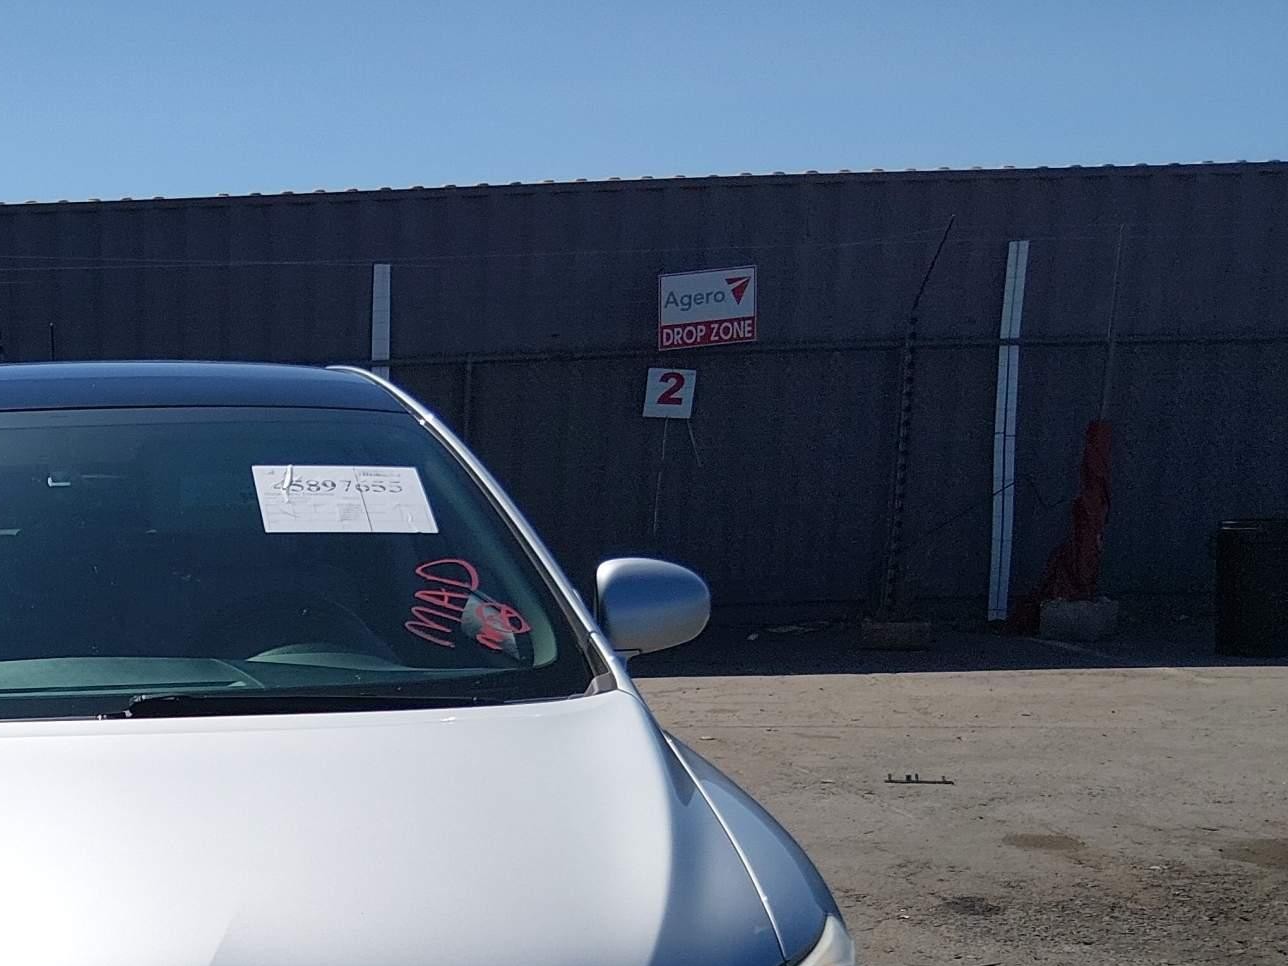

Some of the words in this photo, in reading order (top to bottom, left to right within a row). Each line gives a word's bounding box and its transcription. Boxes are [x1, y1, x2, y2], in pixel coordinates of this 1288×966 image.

[664, 290, 726, 311] Agero
[662, 325, 706, 346] DROP
[710, 320, 753, 342] ZONE
[656, 372, 685, 405] 2
[404, 558, 479, 648] MAD
